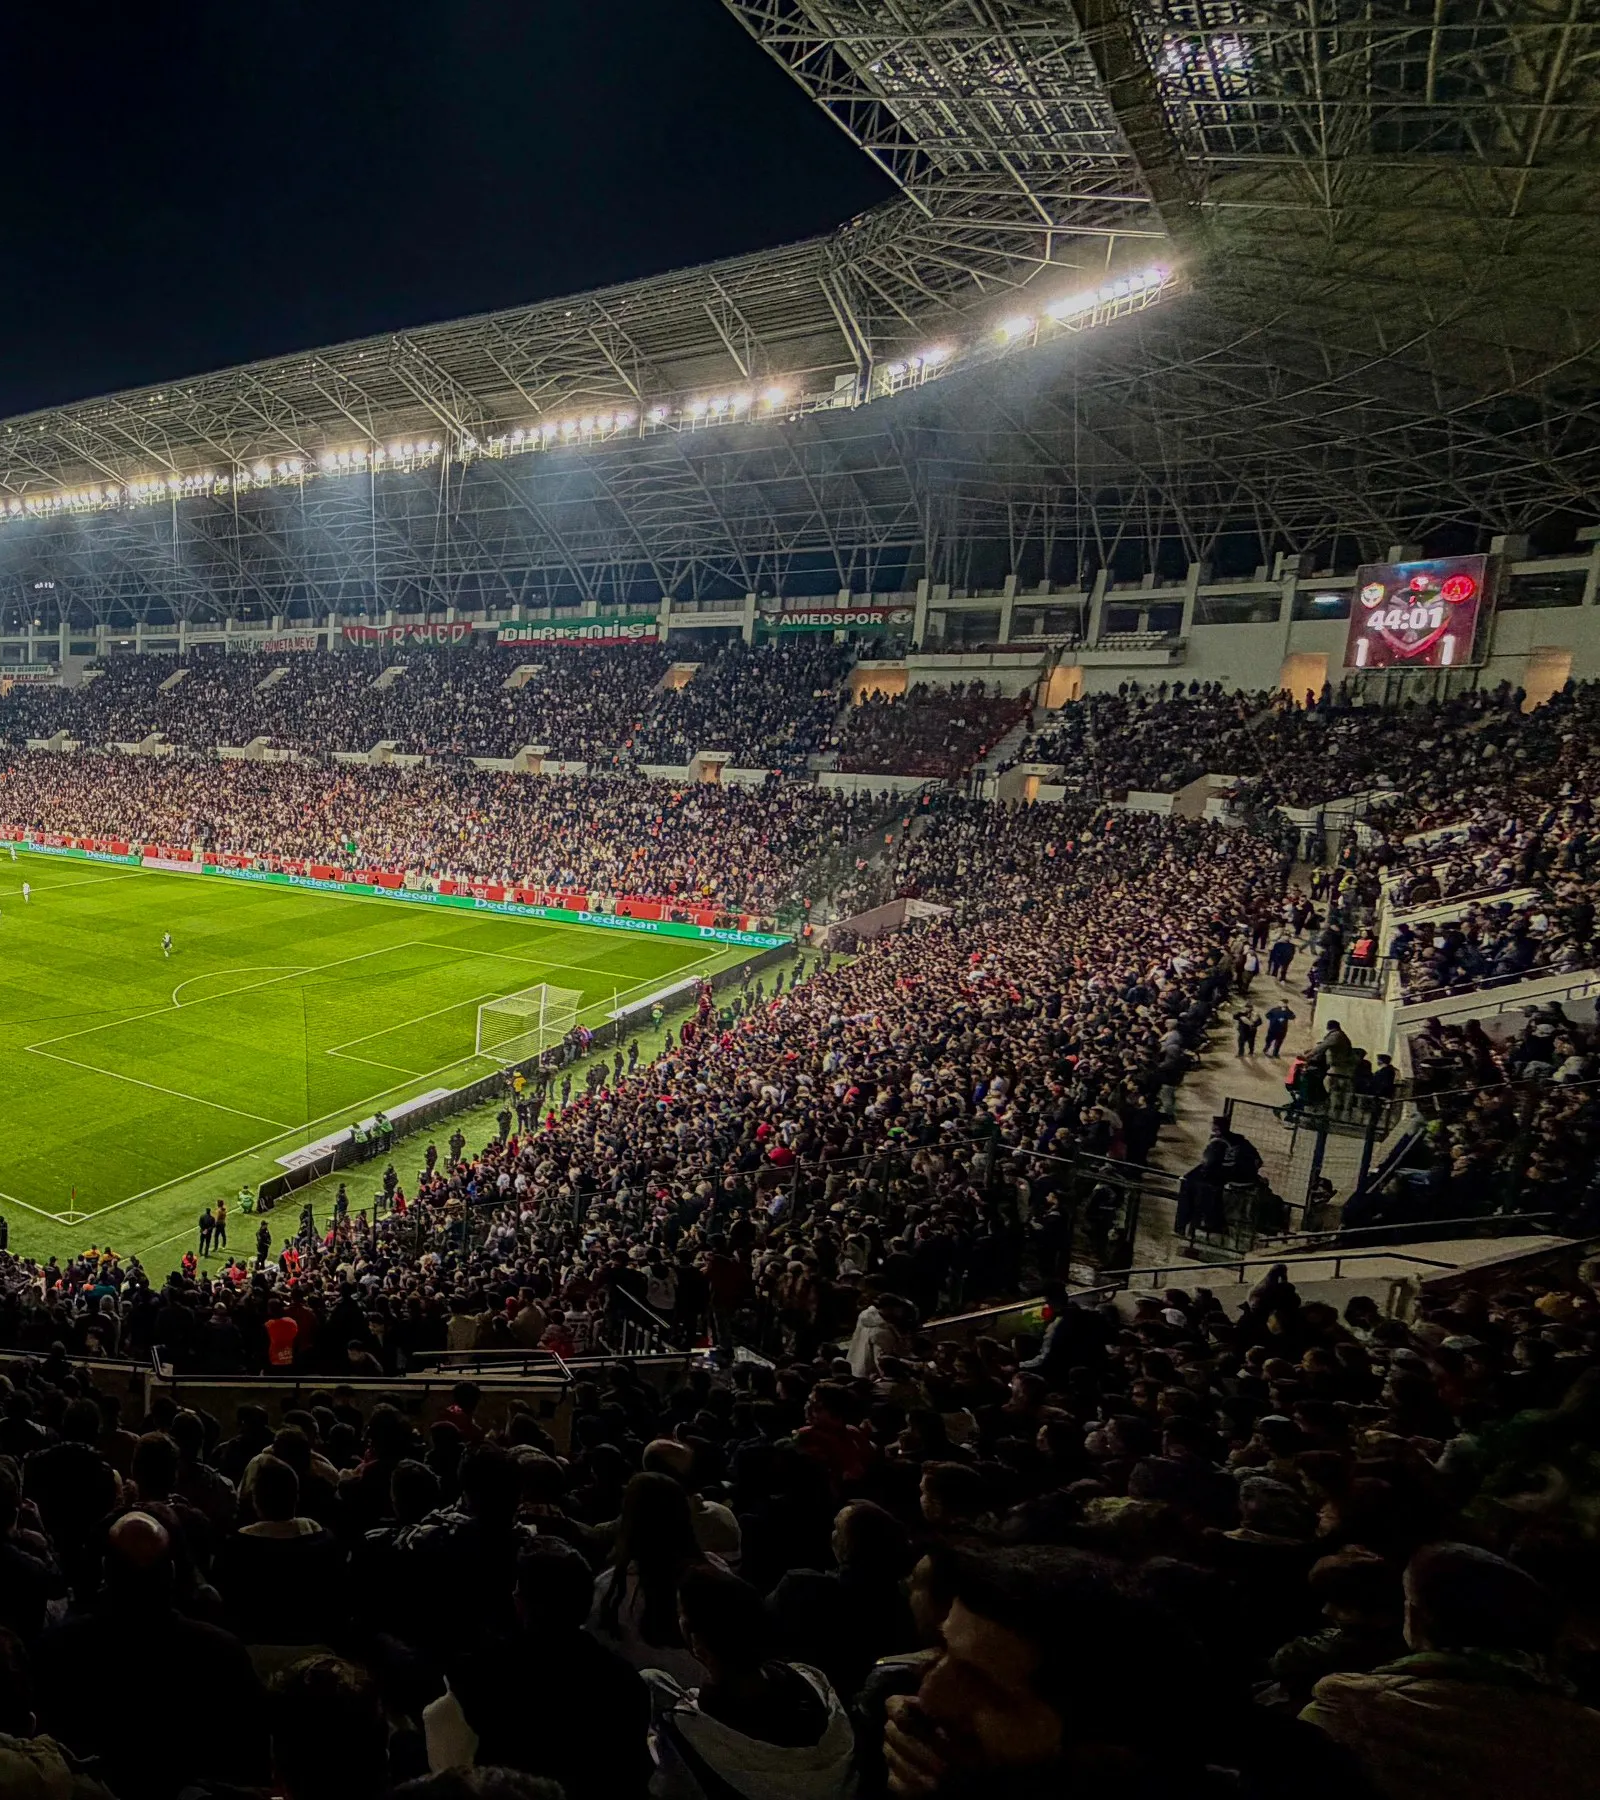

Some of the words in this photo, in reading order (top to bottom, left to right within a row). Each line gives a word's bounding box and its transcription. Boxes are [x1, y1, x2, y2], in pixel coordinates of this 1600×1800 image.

[780, 612, 882, 626] AMEDSPOR
[1367, 607, 1444, 631] 44:01
[289, 876, 345, 890] Dedecan
[373, 886, 437, 902] Dedecan
[474, 898, 546, 916] Dedecan
[578, 911, 658, 931] Dedecan
